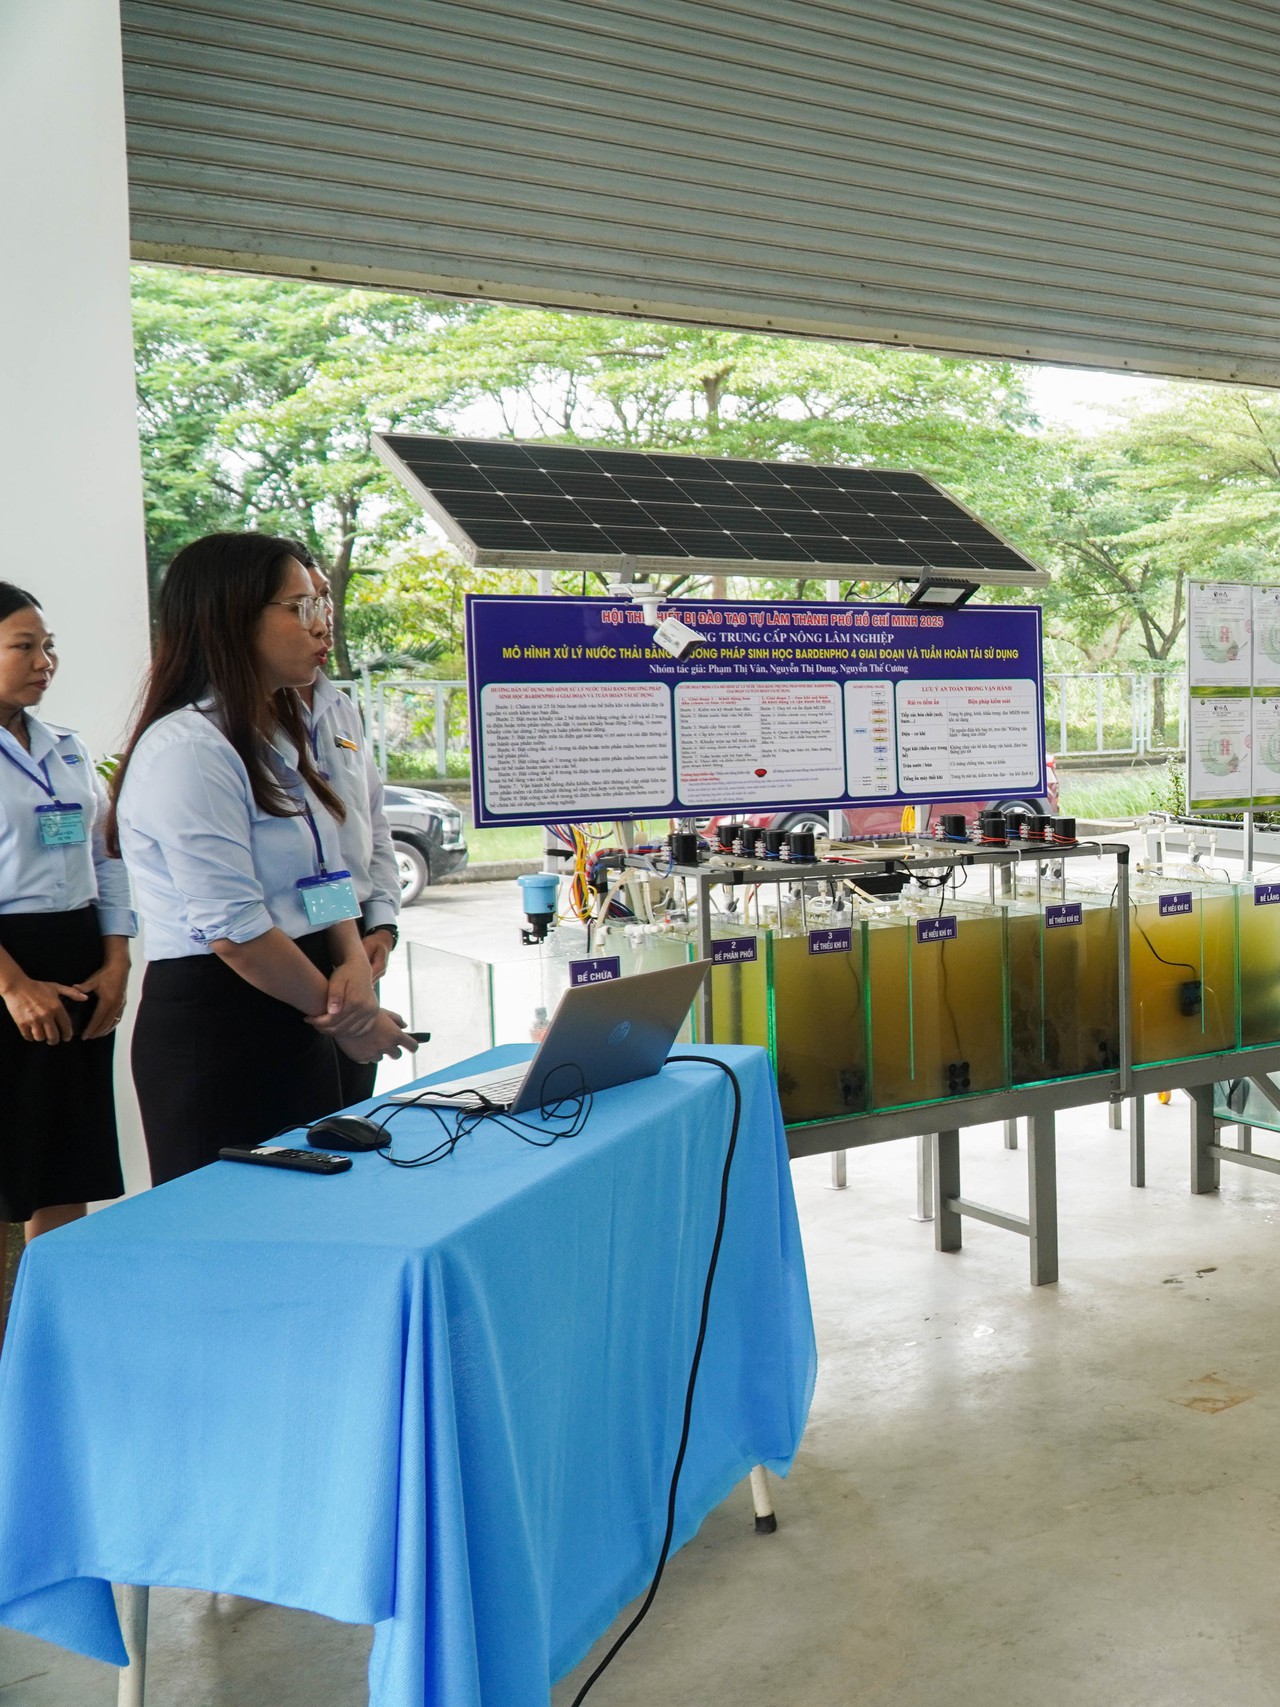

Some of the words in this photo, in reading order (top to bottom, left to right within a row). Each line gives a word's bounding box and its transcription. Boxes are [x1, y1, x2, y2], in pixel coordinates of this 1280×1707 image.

[602, 608, 624, 626] HỘI
[684, 611, 696, 627] BỊ
[698, 609, 722, 625] ĐÀO
[724, 611, 747, 627] TẠO
[749, 611, 765, 628] TỰ
[766, 610, 790, 626] LÀM
[792, 611, 828, 626] THÀNH
[831, 610, 853, 626] PHỐ
[854, 611, 871, 627] HỒ
[872, 612, 890, 627] CHÍ
[891, 614, 918, 627] MINH
[920, 616, 944, 628] 2025
[719, 632, 760, 643] TRUNG
[764, 628, 787, 643] CẤP
[790, 630, 822, 643] NÔNG
[825, 631, 850, 643] LÂM
[852, 631, 895, 645] NGHIỆP
[502, 645, 521, 659] MÔ
[524, 645, 550, 659] HÌNH
[554, 644, 569, 659] XỬ
[571, 645, 583, 659] LÝ
[586, 645, 616, 659] NƯỚC
[619, 644, 642, 659] THẢI
[645, 643, 673, 659] BẰNG
[721, 646, 746, 659] PHÁP
[748, 648, 769, 659] SINH
[772, 648, 793, 661] HỌC
[796, 648, 849, 659] BARDENPHO
[851, 649, 857, 659] 4
[858, 648, 877, 659] GIAI
[880, 649, 905, 661] ĐOẠN
[908, 646, 919, 659] VÀ
[921, 644, 942, 659] TUẦN
[944, 647, 968, 659] HOÀN
[970, 647, 982, 659] TÁI
[984, 646, 995, 659] SỬ
[996, 649, 1019, 661] DỤNG
[649, 664, 675, 674] Nhóm
[677, 665, 689, 674] tác
[691, 665, 706, 675] giả:
[708, 664, 732, 675] Phạm
[733, 664, 748, 675] Thị
[750, 664, 768, 674] Vân,
[770, 663, 799, 675] Nguyễn
[801, 664, 814, 675] Thị
[816, 664, 838, 675] Dung,
[840, 662, 868, 675] Nguyễn
[870, 662, 884, 673] Thế
[885, 664, 908, 674] Cương
[828, 932, 833, 940] 3
[723, 950, 739, 961] PHÂN
[590, 969, 613, 981] CHỨA
